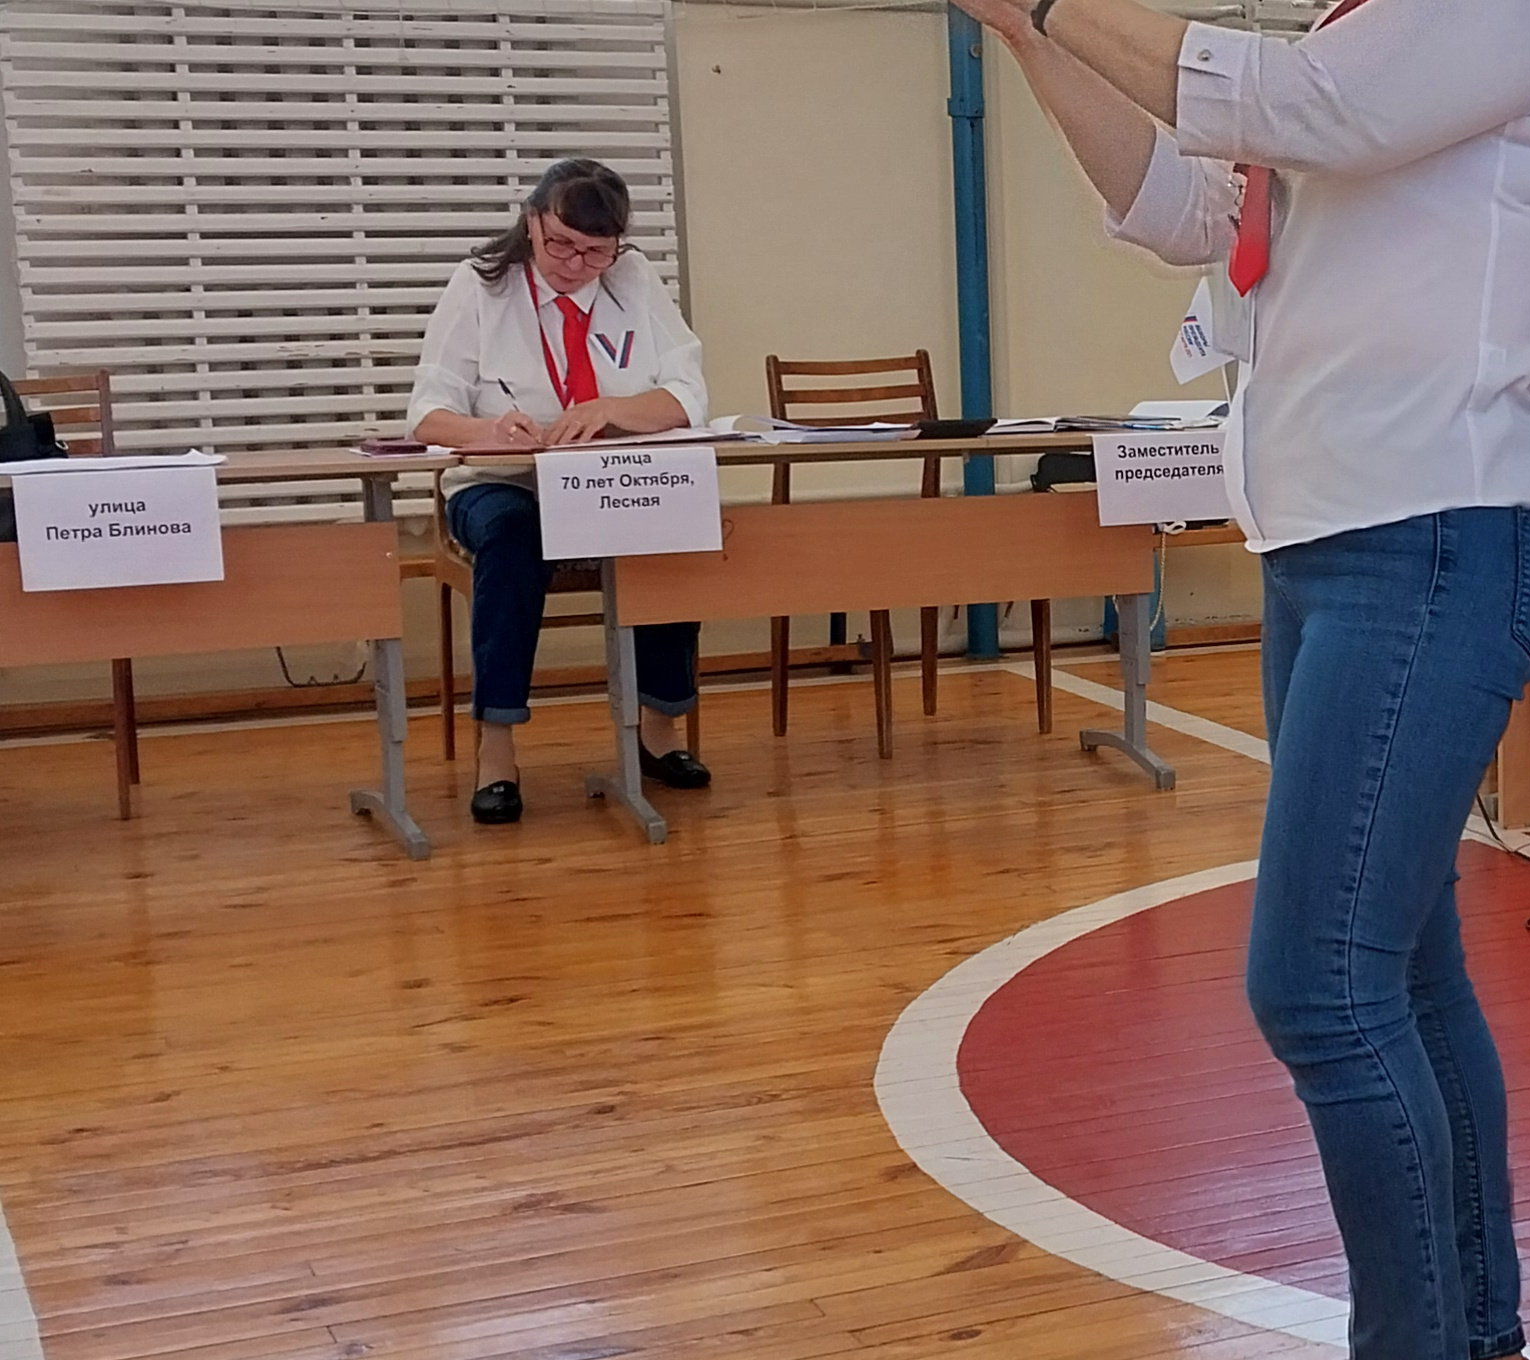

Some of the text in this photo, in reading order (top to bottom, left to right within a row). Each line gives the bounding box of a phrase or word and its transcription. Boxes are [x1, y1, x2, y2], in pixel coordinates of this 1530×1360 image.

[1117, 444, 1220, 458] Заместитель
[600, 454, 652, 468] улица
[561, 472, 695, 490] 70 лет Октября,
[1115, 464, 1224, 482] председателя
[88, 501, 146, 517] улица
[599, 496, 660, 509] Лесная
[46, 522, 192, 542] Петра Блинова
